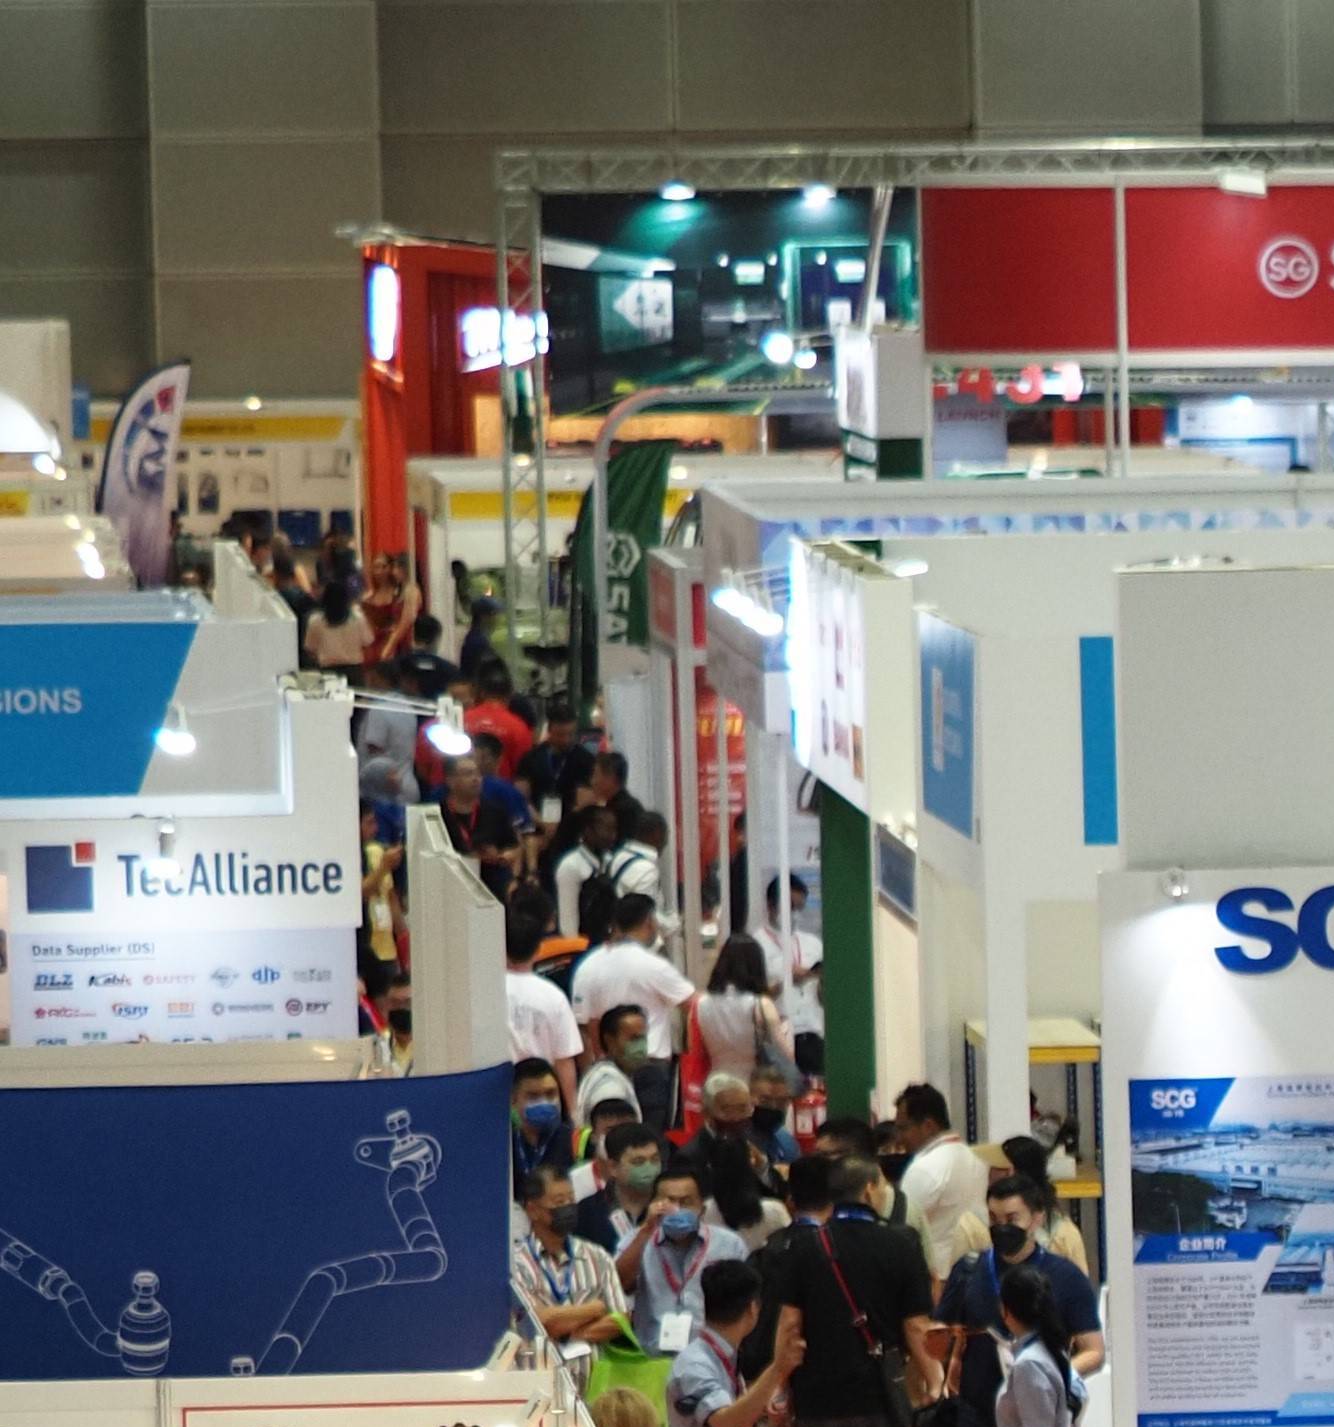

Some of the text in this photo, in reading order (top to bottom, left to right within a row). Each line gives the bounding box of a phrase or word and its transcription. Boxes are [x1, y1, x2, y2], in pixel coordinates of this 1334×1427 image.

[32, 945, 62, 956] Data
[67, 944, 122, 957] Supplier
[1151, 1088, 1197, 1110] SCG
